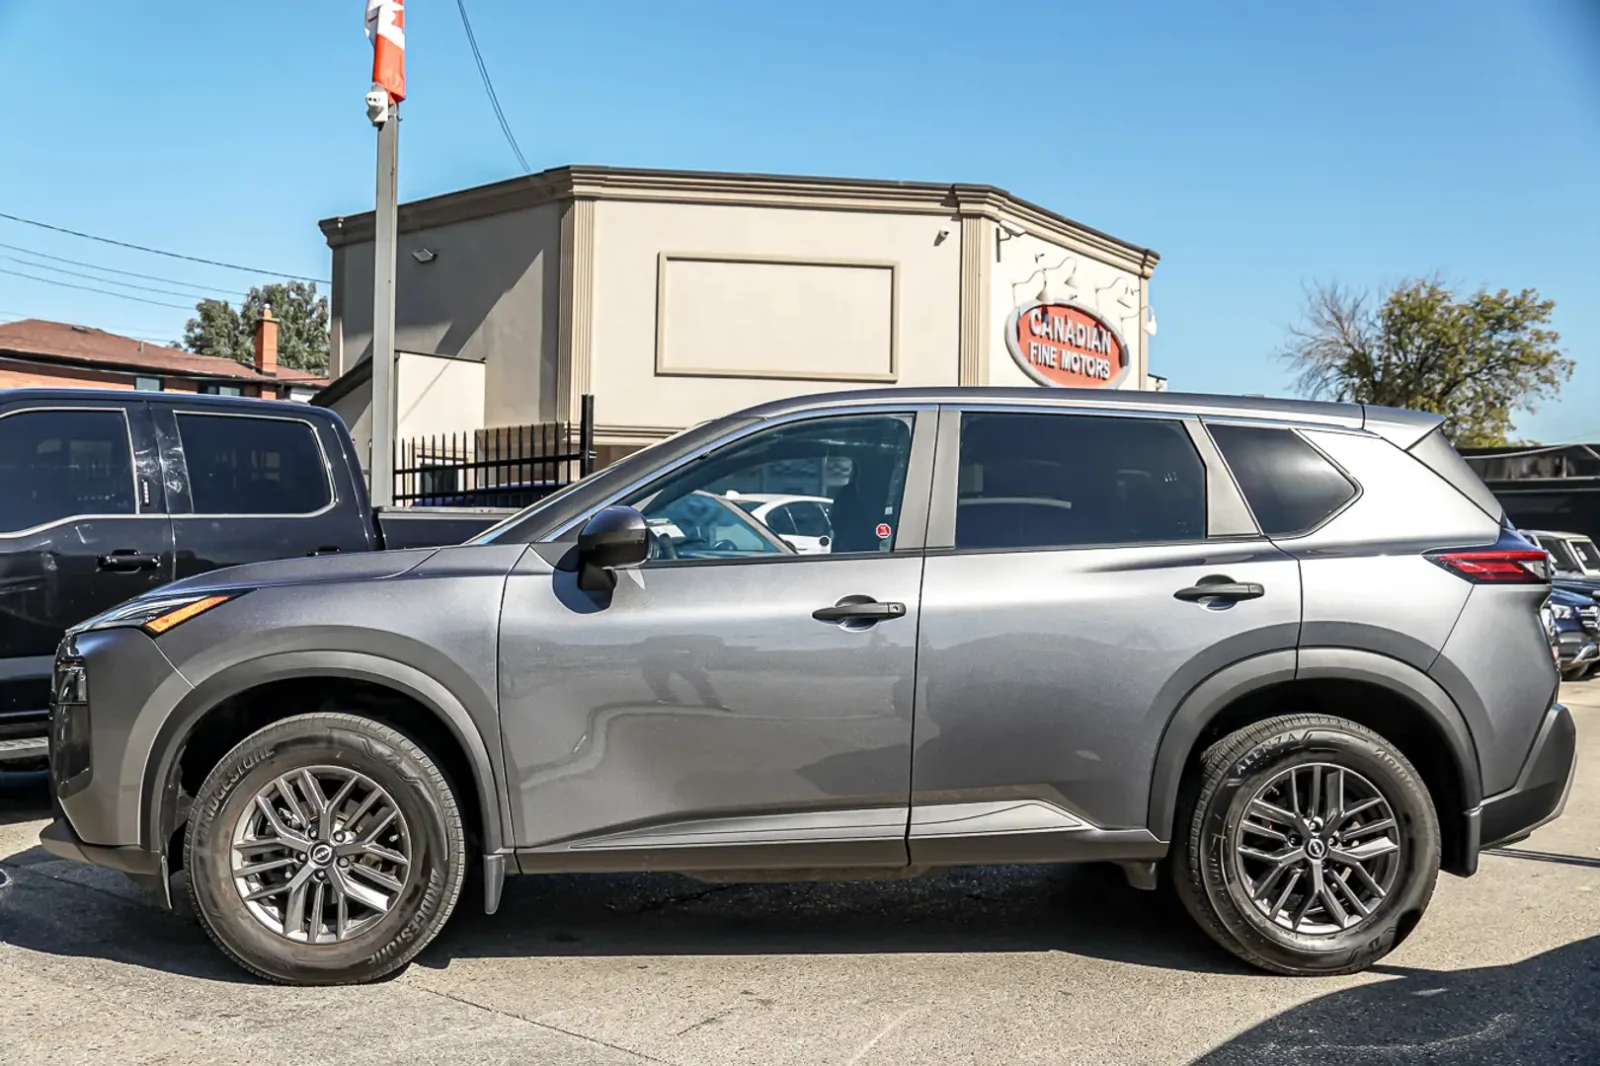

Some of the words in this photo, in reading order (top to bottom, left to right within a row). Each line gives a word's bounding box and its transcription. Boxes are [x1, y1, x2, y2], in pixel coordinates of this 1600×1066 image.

[1029, 308, 1111, 355] CANADIAN
[1029, 341, 1057, 368] FINE
[1060, 349, 1111, 380] MOTORS
[1236, 732, 1297, 775] ALENZA
[367, 867, 440, 965] BRIDGESTONE
